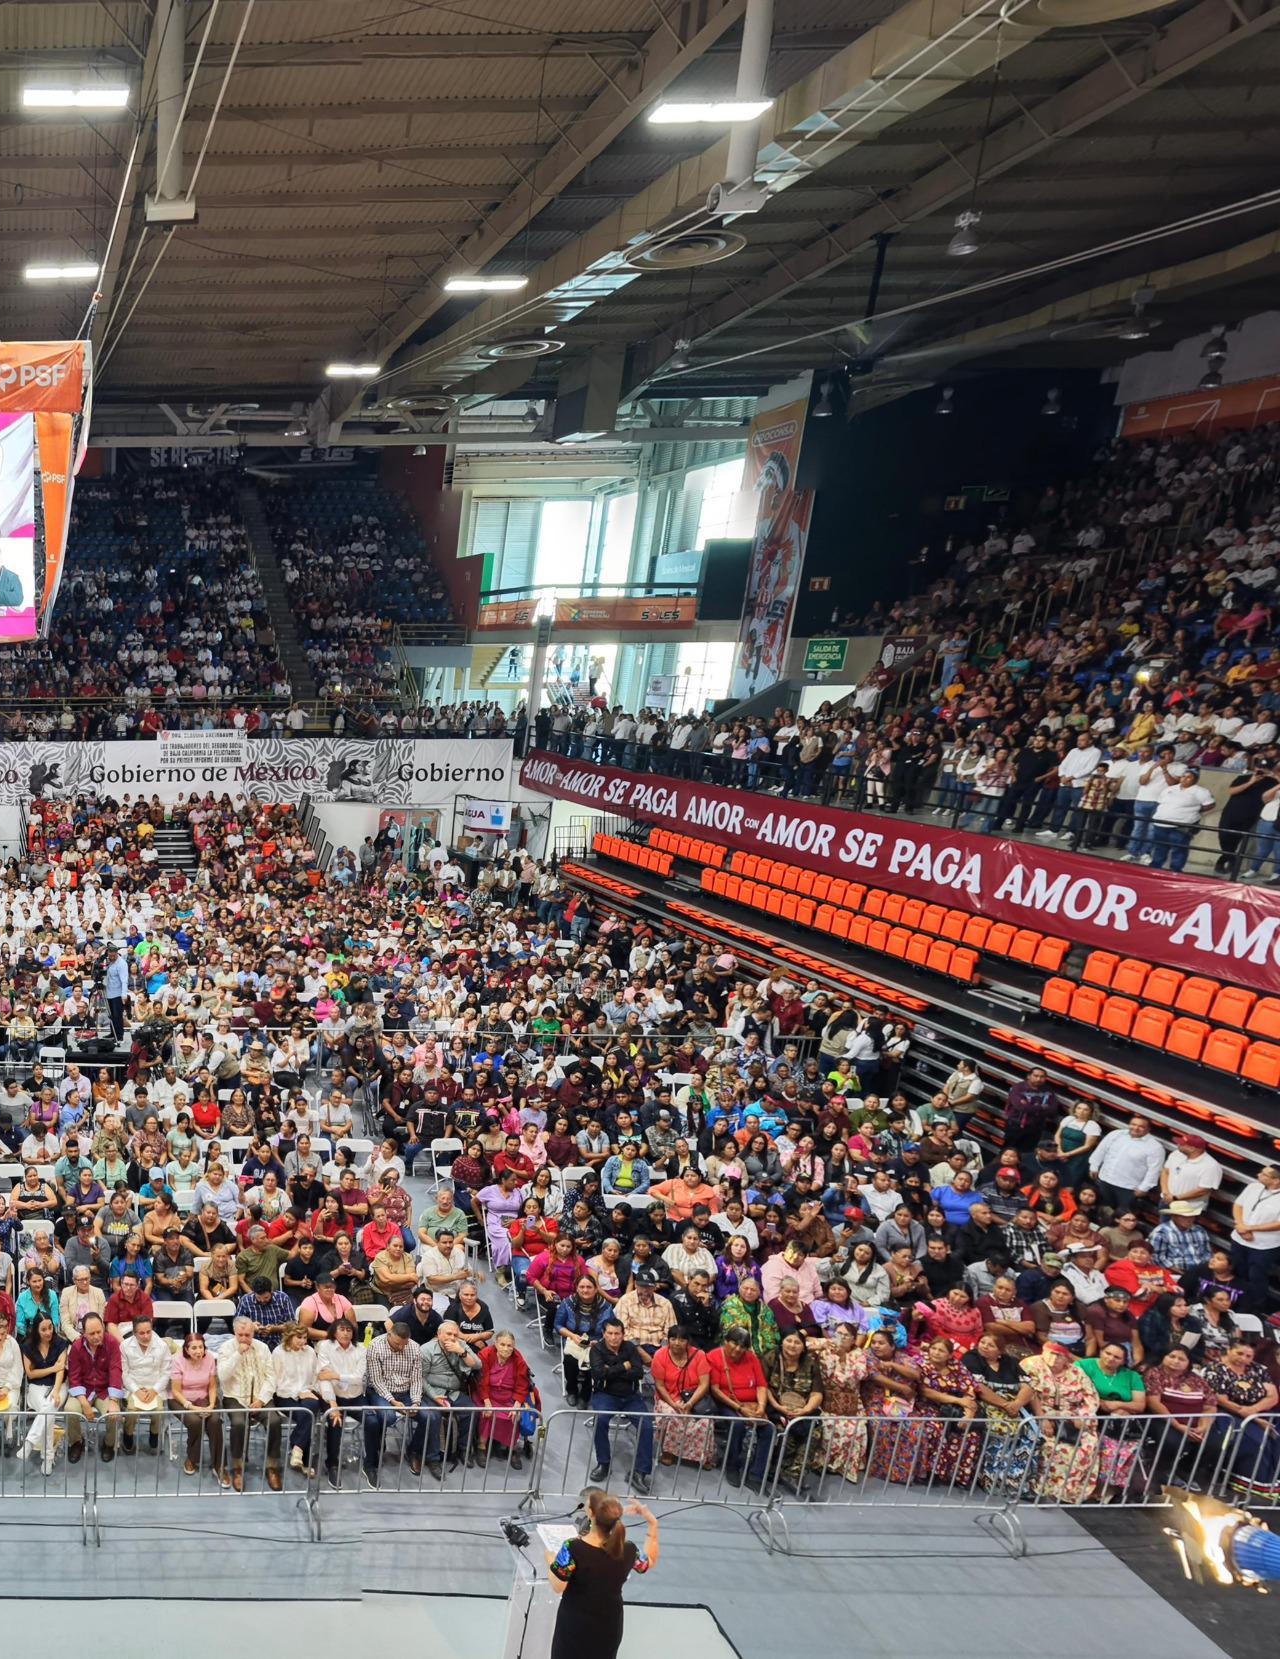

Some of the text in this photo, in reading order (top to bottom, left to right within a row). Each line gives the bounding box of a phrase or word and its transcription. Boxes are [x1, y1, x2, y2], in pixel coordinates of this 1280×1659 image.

[21, 364, 66, 387] PSF
[813, 645, 831, 653] SALIDA
[896, 646, 915, 654] BAJA
[89, 760, 317, 783] Gobierno de México
[397, 762, 505, 783] Gobierno
[523, 758, 557, 786] AMOR
[560, 769, 605, 798] AMOR
[603, 778, 631, 805] SE
[629, 783, 678, 818] PAGA
[684, 795, 745, 835] AMOR
[744, 817, 760, 829] CON
[756, 812, 836, 858] AMOR
[838, 828, 884, 869] SE
[887, 838, 982, 894] PAGA
[993, 863, 1138, 931] AMOR
[1138, 906, 1177, 927] CON
[1169, 902, 1280, 967] AM
